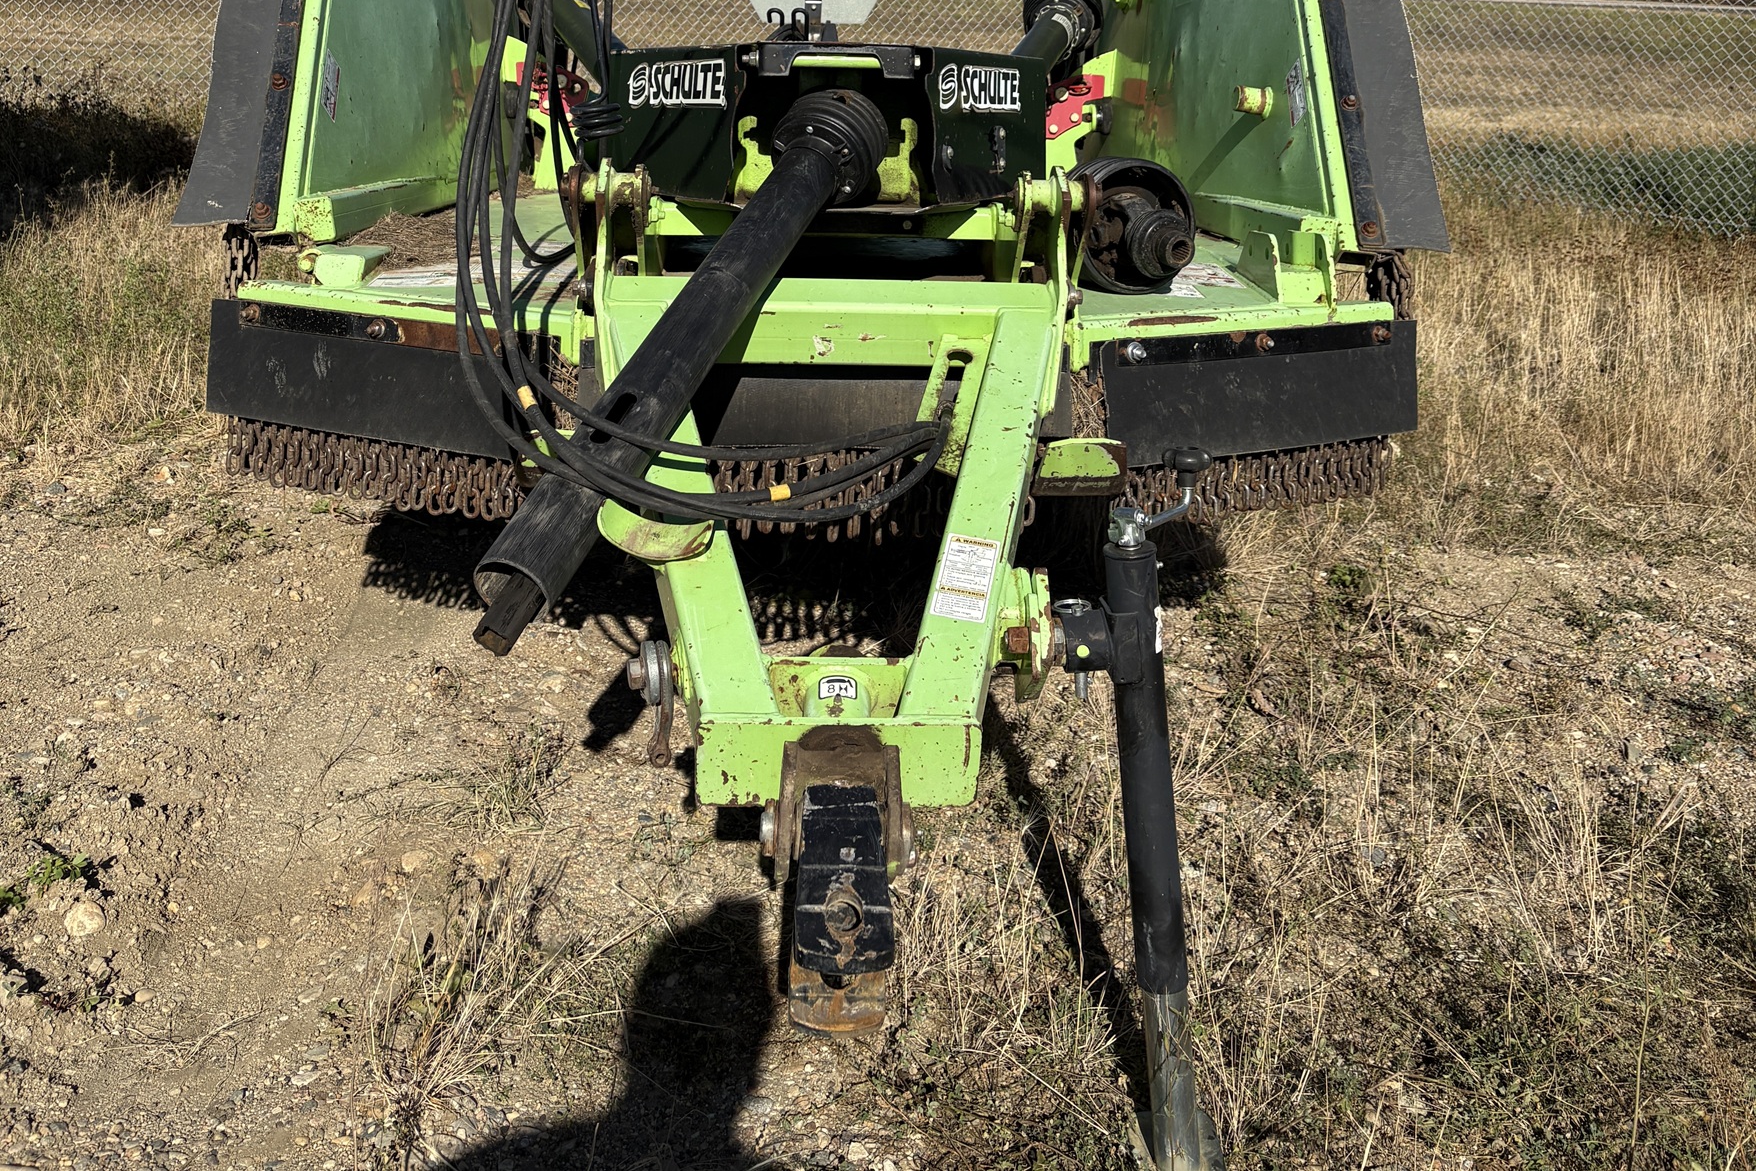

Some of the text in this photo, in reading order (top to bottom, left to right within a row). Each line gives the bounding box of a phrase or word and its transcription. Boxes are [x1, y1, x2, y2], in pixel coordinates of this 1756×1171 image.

[651, 61, 724, 103] SCHULTE
[962, 67, 1019, 107] SCHULTE
[963, 539, 994, 548] WARNING
[946, 587, 986, 597] ADVERTENCIA
